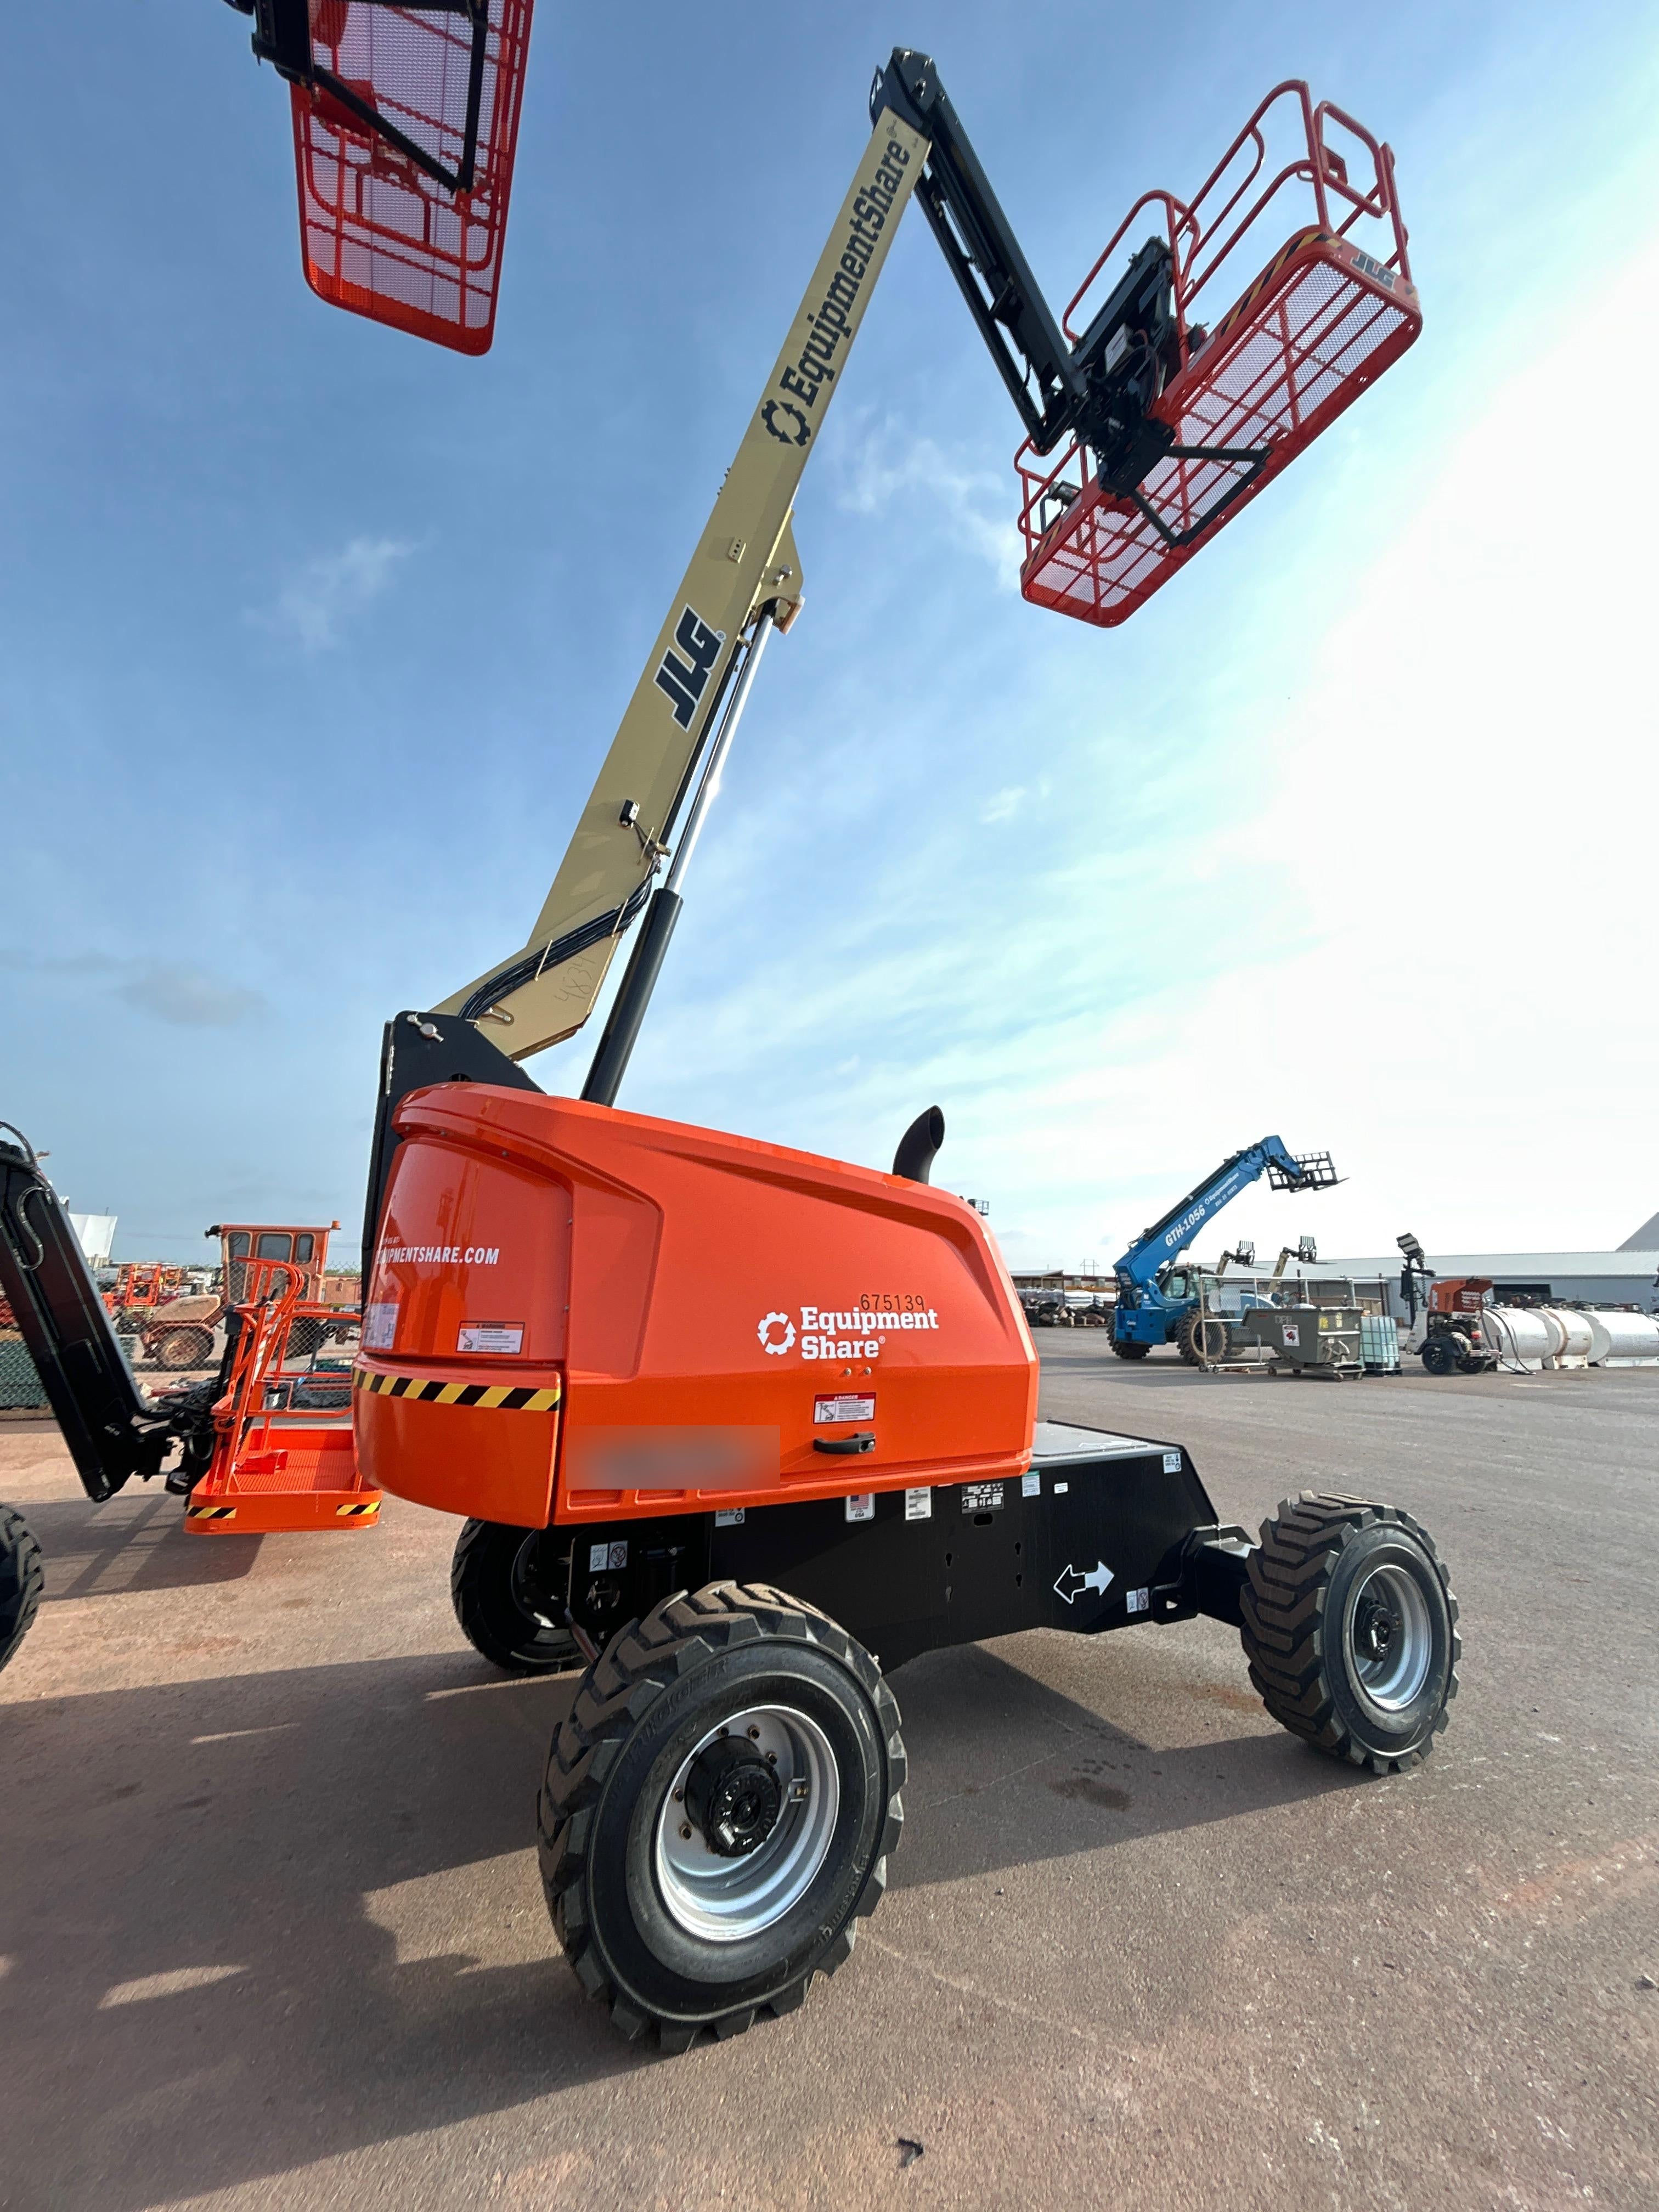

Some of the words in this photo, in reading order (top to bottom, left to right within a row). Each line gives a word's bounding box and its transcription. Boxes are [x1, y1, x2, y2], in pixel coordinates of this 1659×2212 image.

[780, 140, 911, 408] EquipmentShare
[1350, 251, 1396, 293] JLG
[653, 602, 724, 733] JLG
[1165, 1204, 1205, 1246] GTH-1056
[800, 1306, 939, 1335] Equipment
[860, 1294, 925, 1311] 675139
